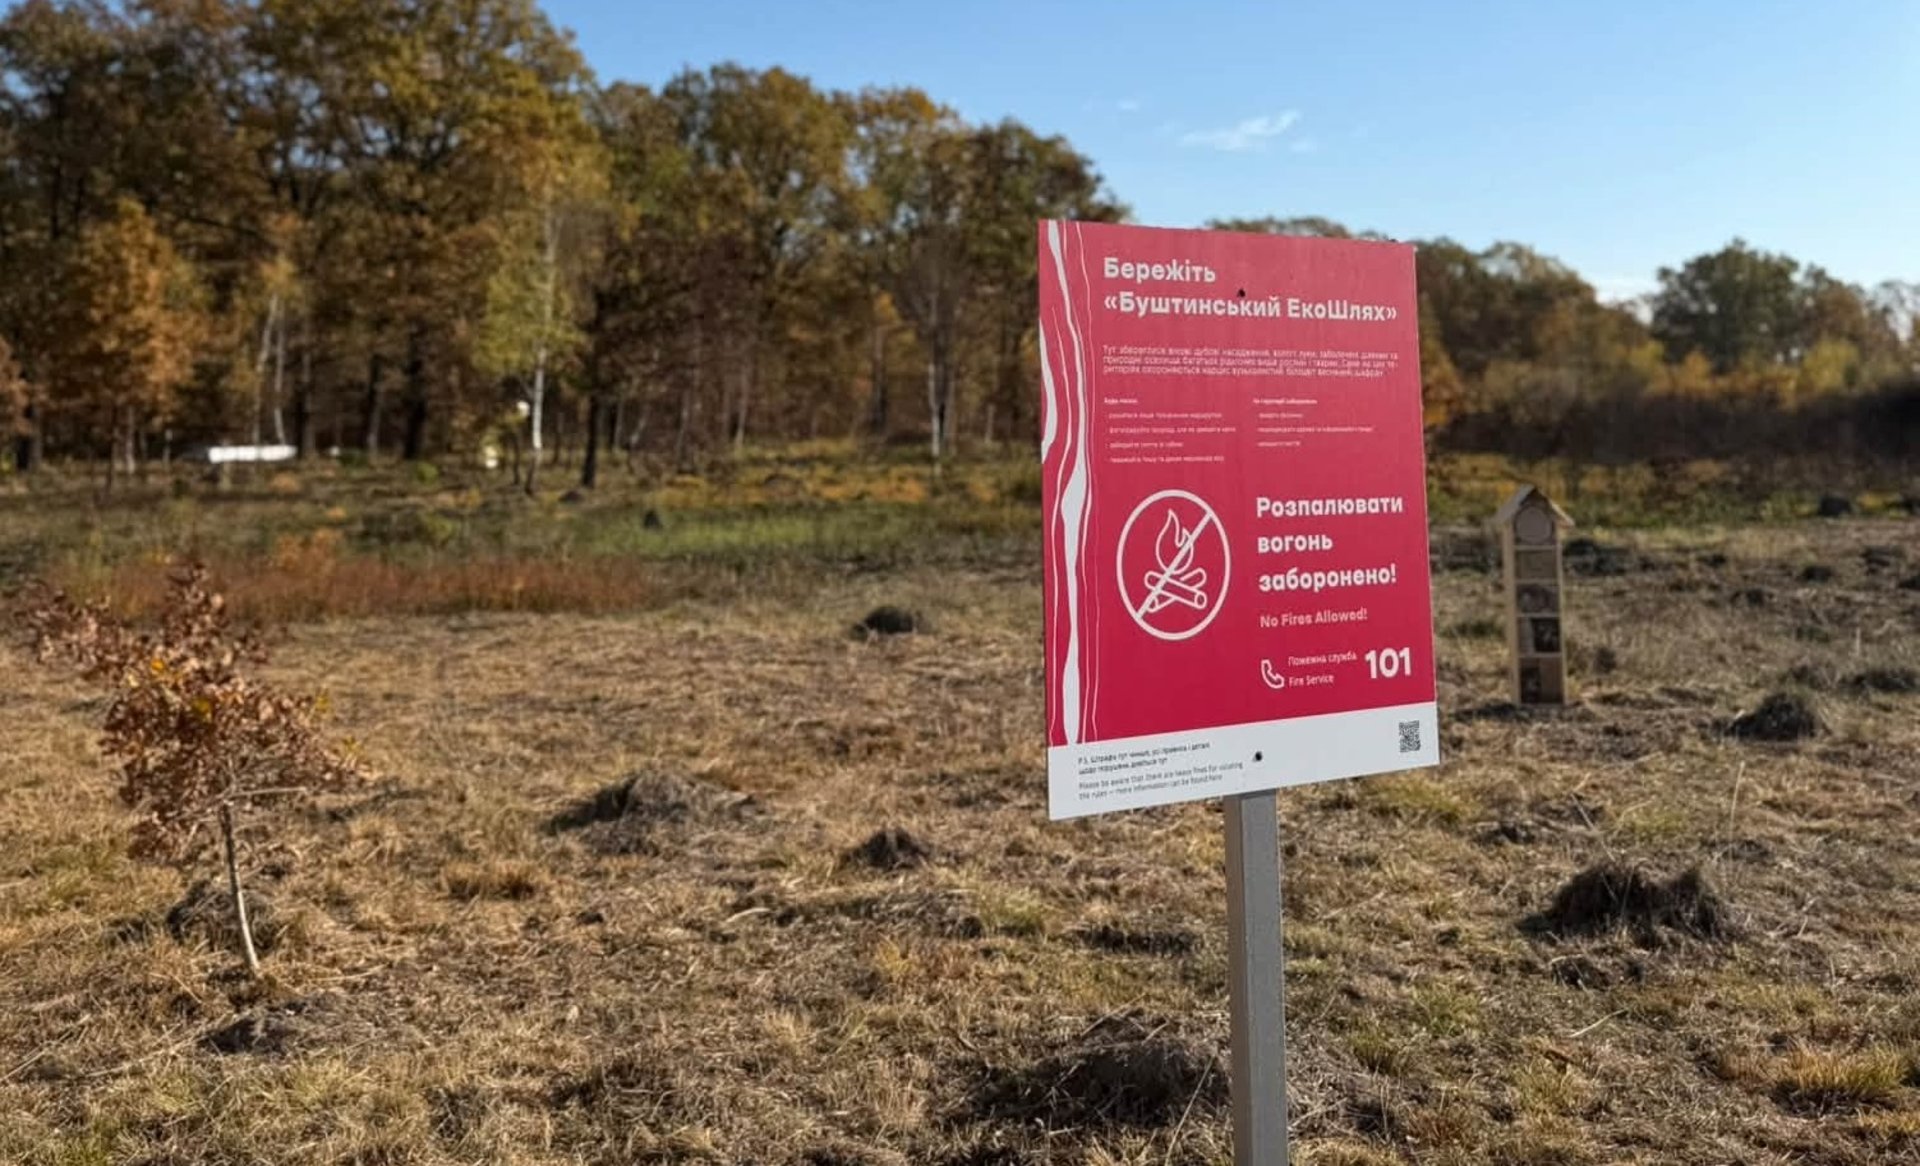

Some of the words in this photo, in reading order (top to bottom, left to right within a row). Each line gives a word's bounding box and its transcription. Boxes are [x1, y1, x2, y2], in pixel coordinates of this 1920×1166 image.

[1104, 257, 1217, 283] Бережіть
[1104, 291, 1281, 318] «Буштинський
[1287, 299, 1398, 322] ЕкоШлях»
[1256, 496, 1403, 518] Розпалювати
[1257, 534, 1333, 554] вогонь
[1259, 563, 1397, 592] заборонено!
[1260, 614, 1279, 628] No
[1281, 612, 1312, 626] Fires
[1315, 607, 1368, 624] Allowed!
[1365, 647, 1412, 679] 101
[1289, 676, 1304, 688] Fire
[1306, 673, 1335, 686] Service
